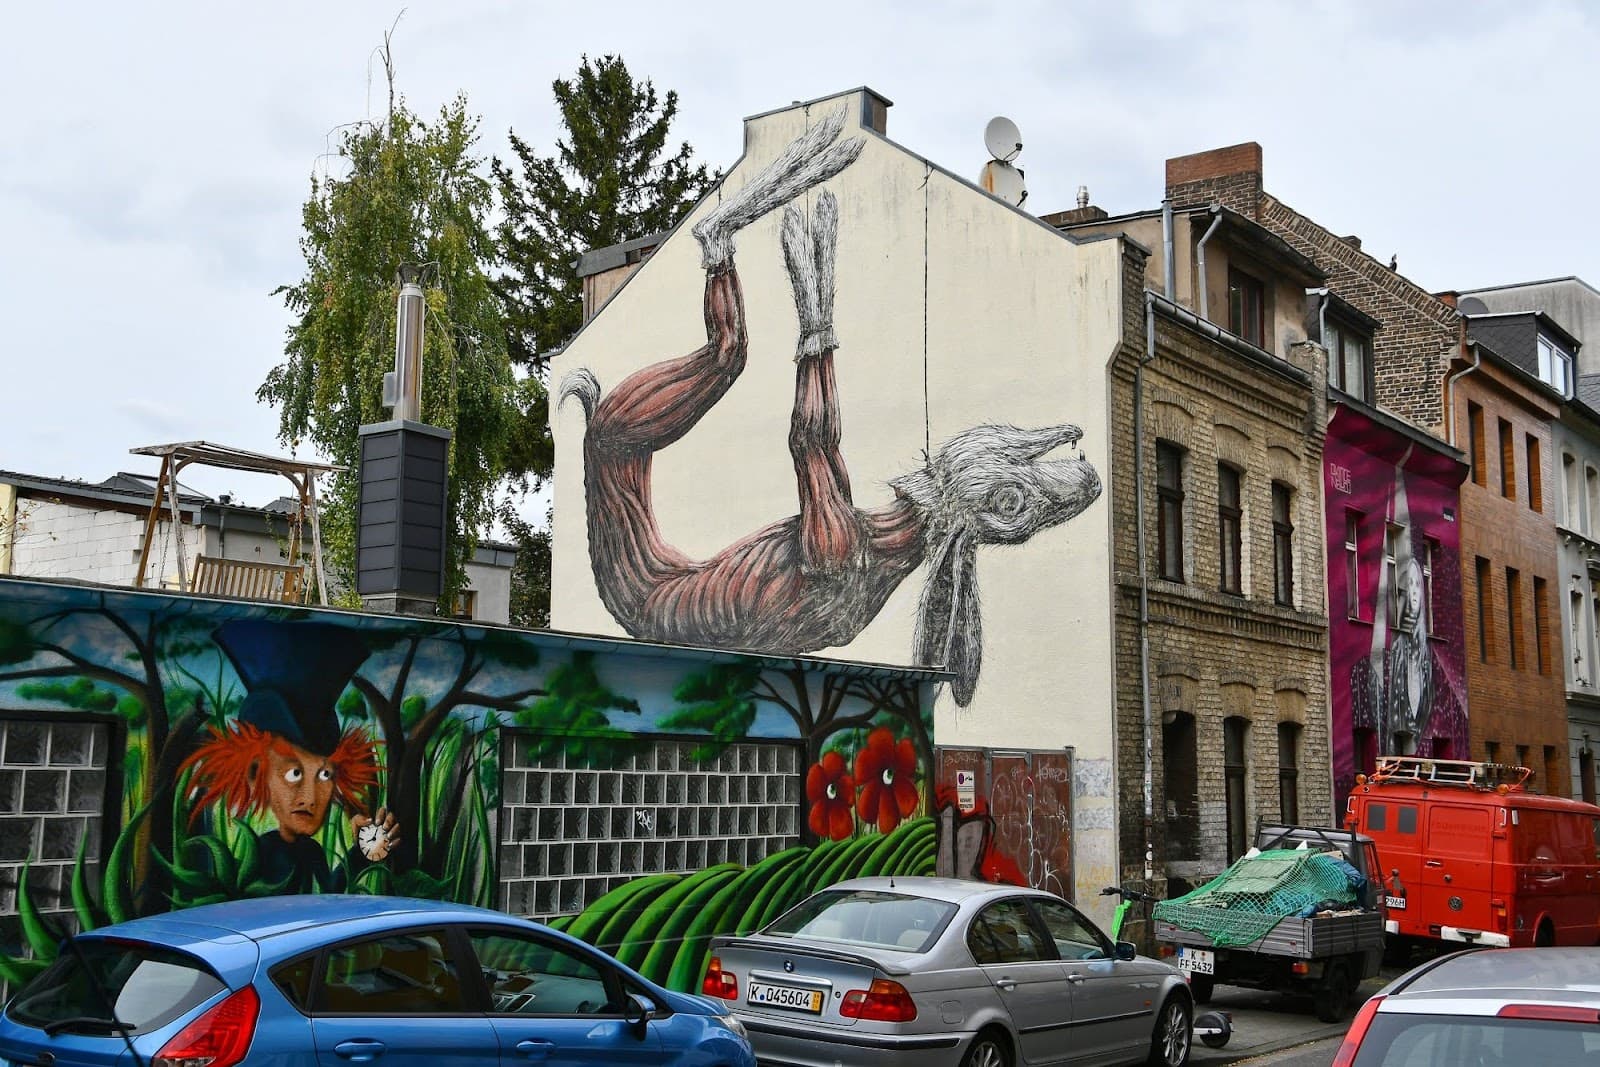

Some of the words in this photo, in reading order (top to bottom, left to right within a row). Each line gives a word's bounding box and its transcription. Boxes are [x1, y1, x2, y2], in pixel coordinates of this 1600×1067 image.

[1191, 950, 1196, 960] K
[1191, 961, 1212, 973] 5432
[751, 985, 760, 1000] K
[766, 987, 810, 1007] 045604
